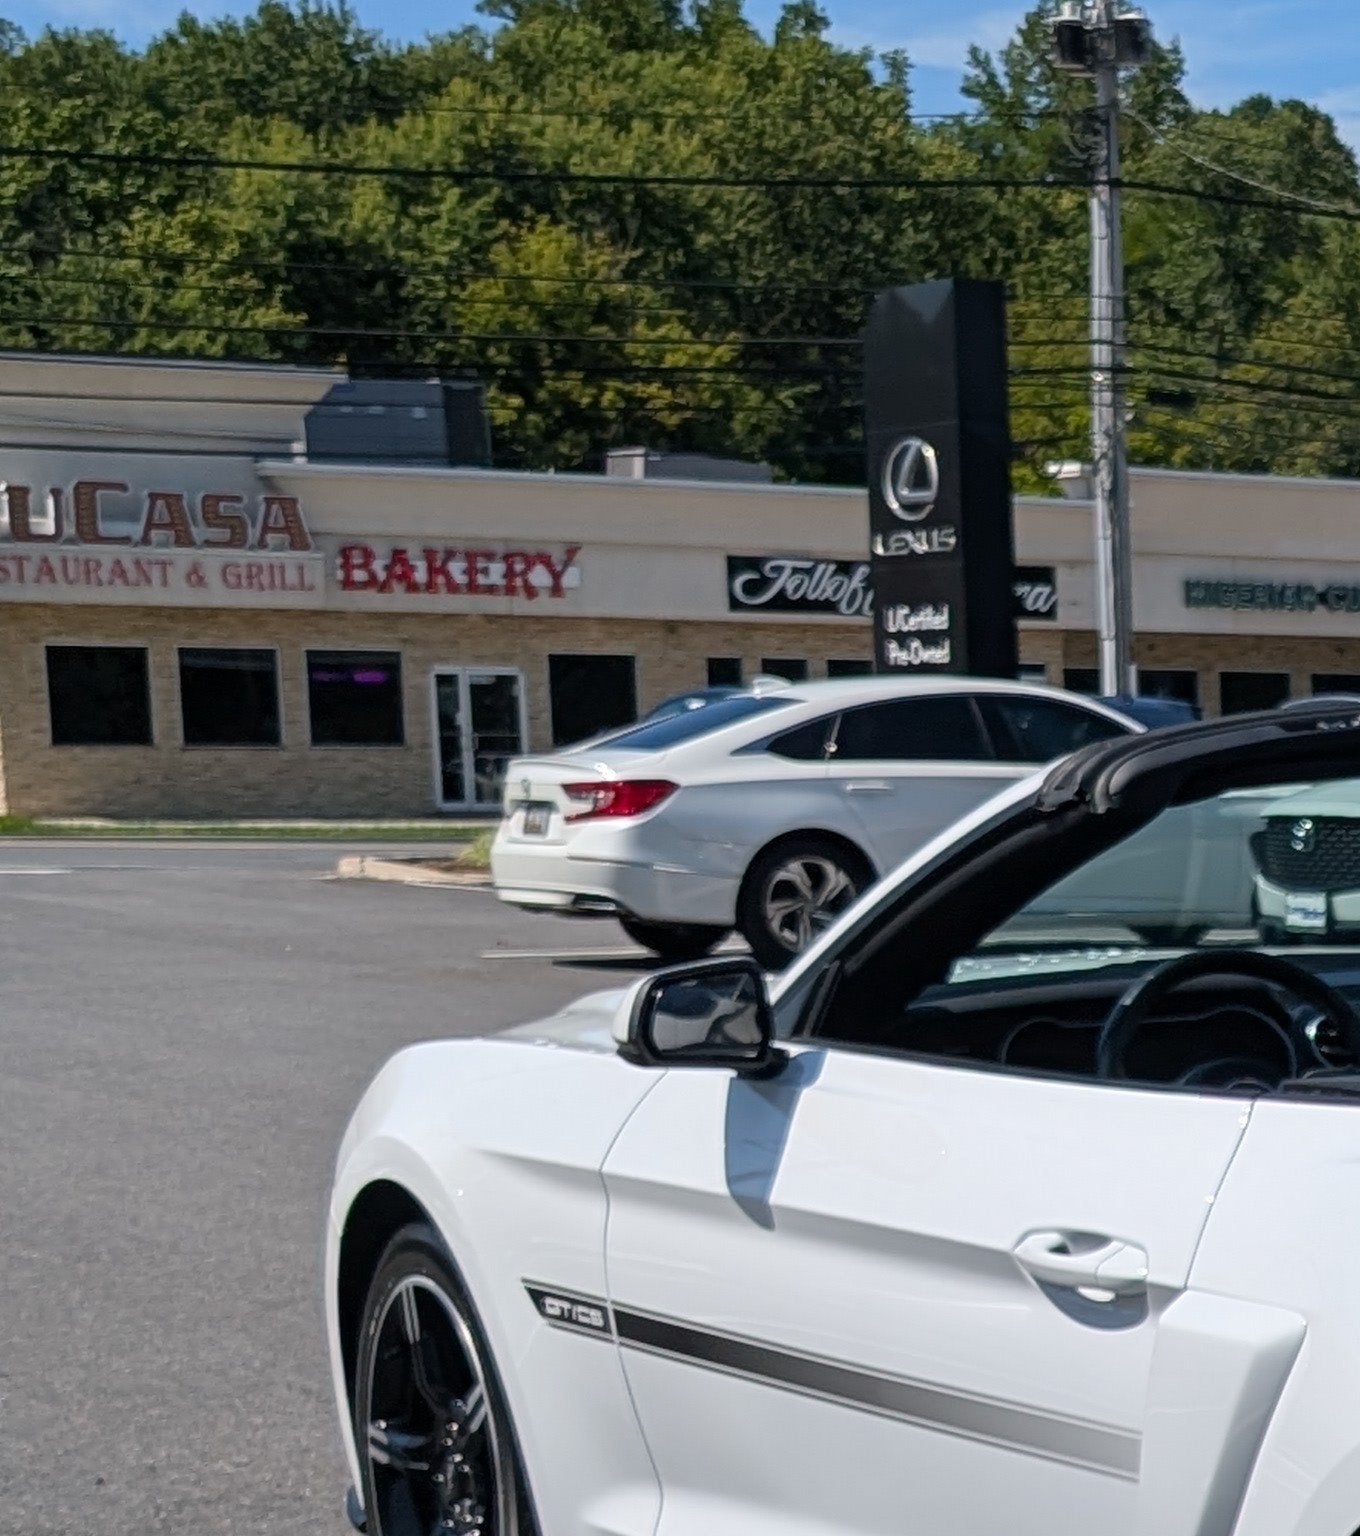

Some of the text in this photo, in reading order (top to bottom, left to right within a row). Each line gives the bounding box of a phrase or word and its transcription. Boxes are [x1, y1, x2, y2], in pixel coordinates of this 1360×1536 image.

[3, 480, 312, 549] UCASA
[872, 527, 957, 556] LEXUS
[185, 561, 208, 590] &
[221, 559, 316, 593] GRILL
[339, 541, 583, 600] BAKERY
